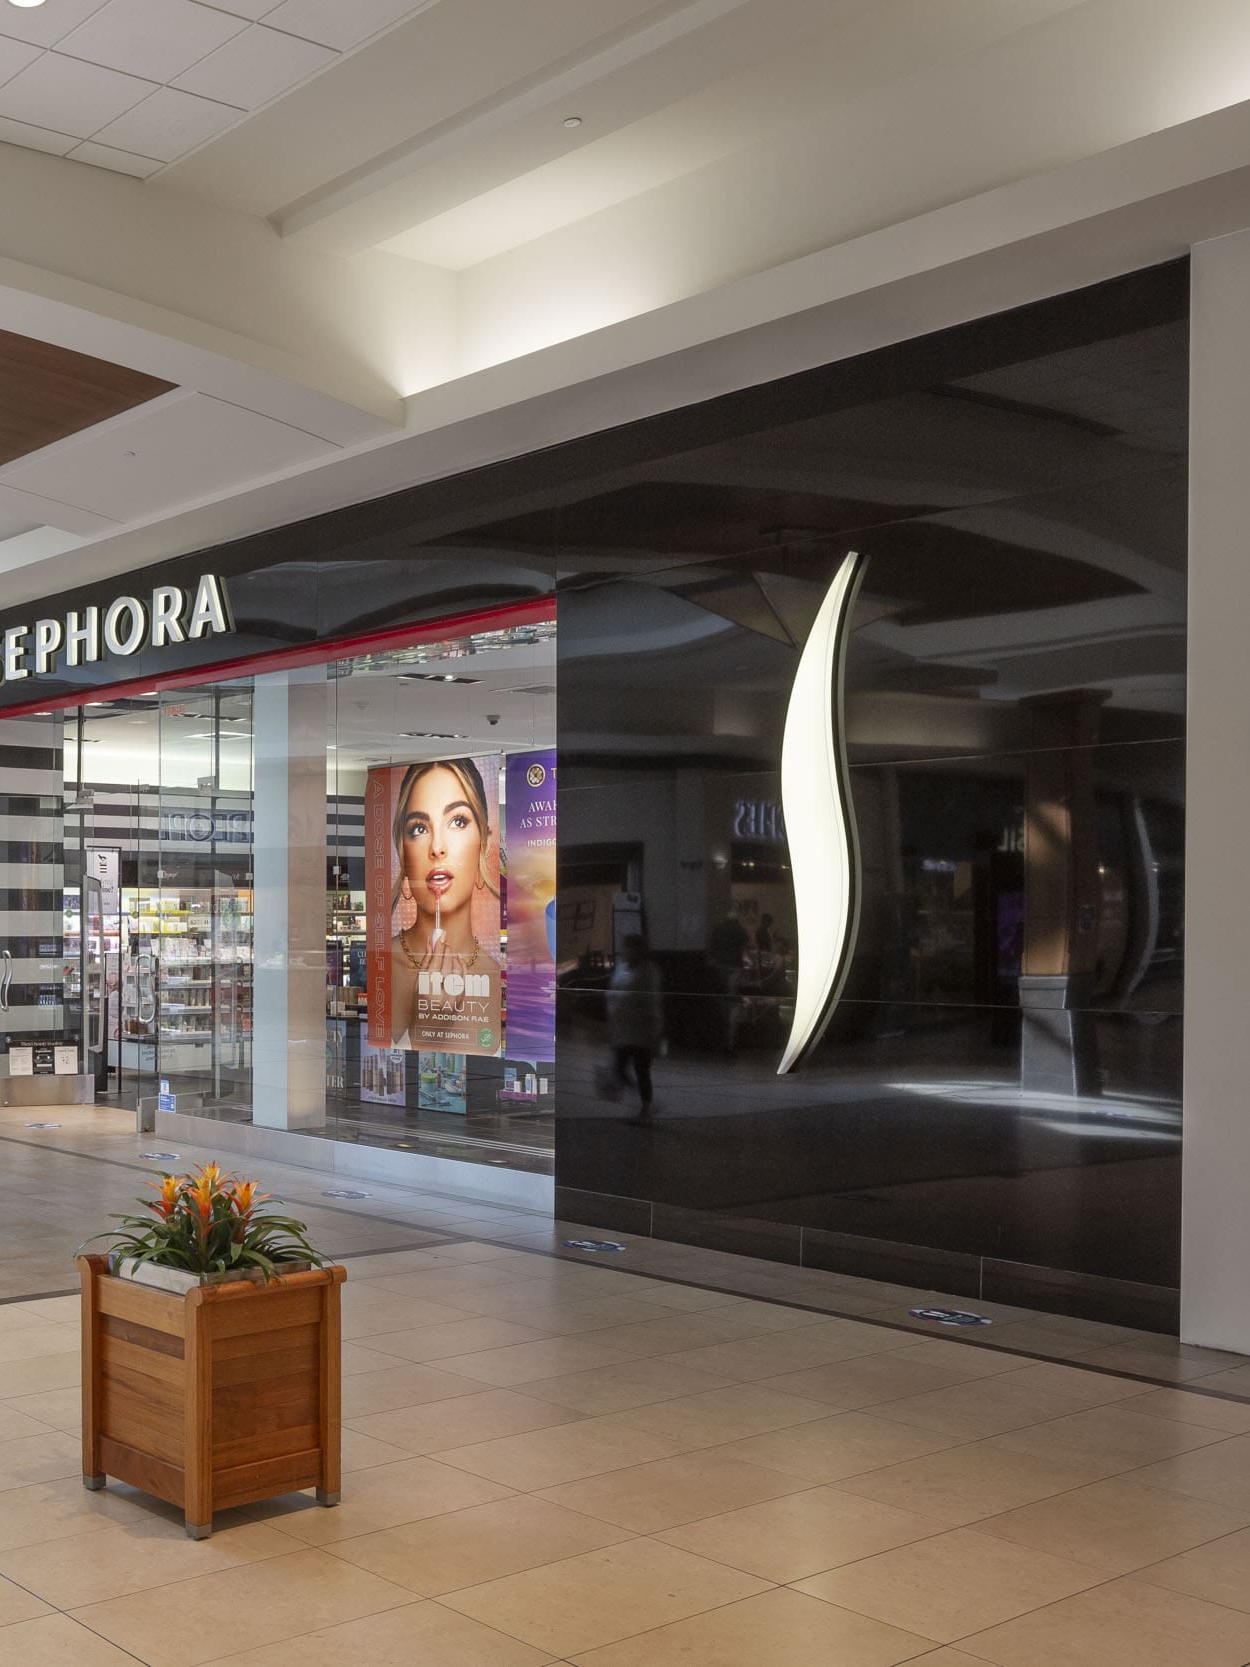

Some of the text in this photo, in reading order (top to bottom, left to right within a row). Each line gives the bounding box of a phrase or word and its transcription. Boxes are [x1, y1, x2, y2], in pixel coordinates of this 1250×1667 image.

[373, 803, 385, 870] DOSE
[519, 818, 532, 829] AS
[374, 875, 385, 907] OF
[374, 912, 385, 971] SELF
[418, 971, 490, 997] item
[375, 976, 385, 1038] LOVE
[418, 999, 490, 1013] BEAUTY
[432, 1014, 469, 1022] ADDISON
[471, 1015, 489, 1023] RAE
[445, 1032, 470, 1040] SEPHORA
